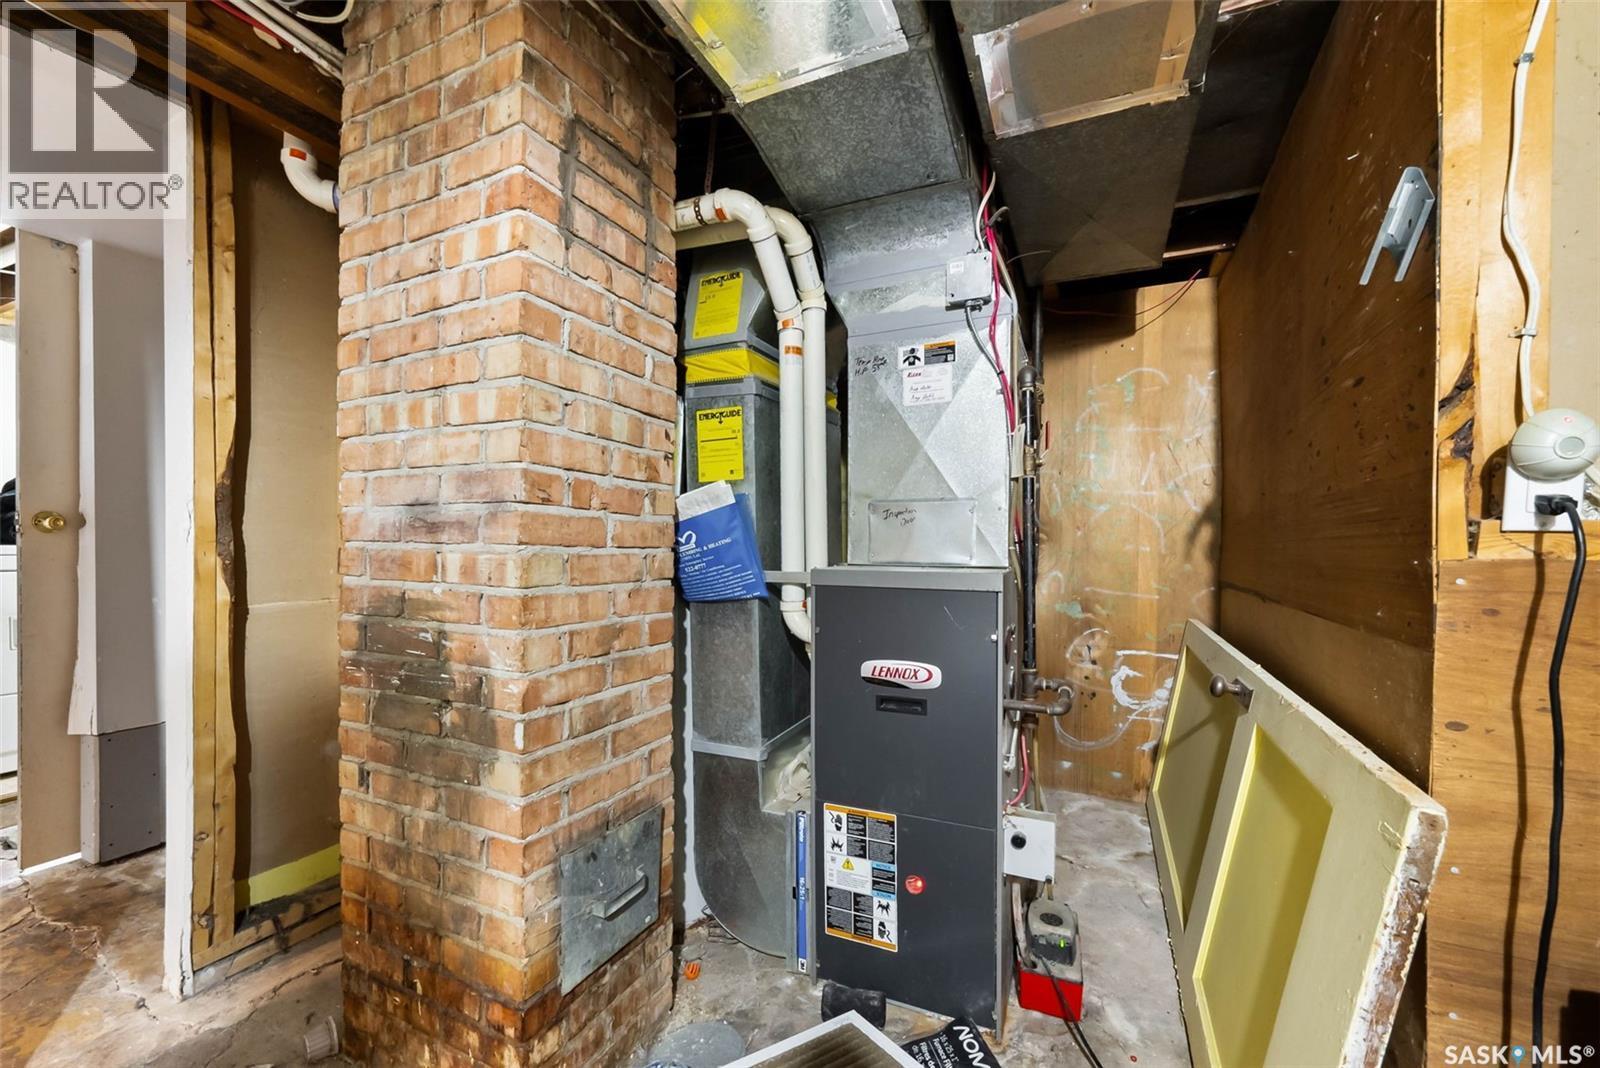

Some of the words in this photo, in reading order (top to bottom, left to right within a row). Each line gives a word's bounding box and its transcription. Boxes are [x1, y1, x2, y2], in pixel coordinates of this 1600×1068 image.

[871, 665, 921, 680] LENNOX
[920, 1041, 931, 1061] Filtres
[933, 1038, 947, 1060] Furnace
